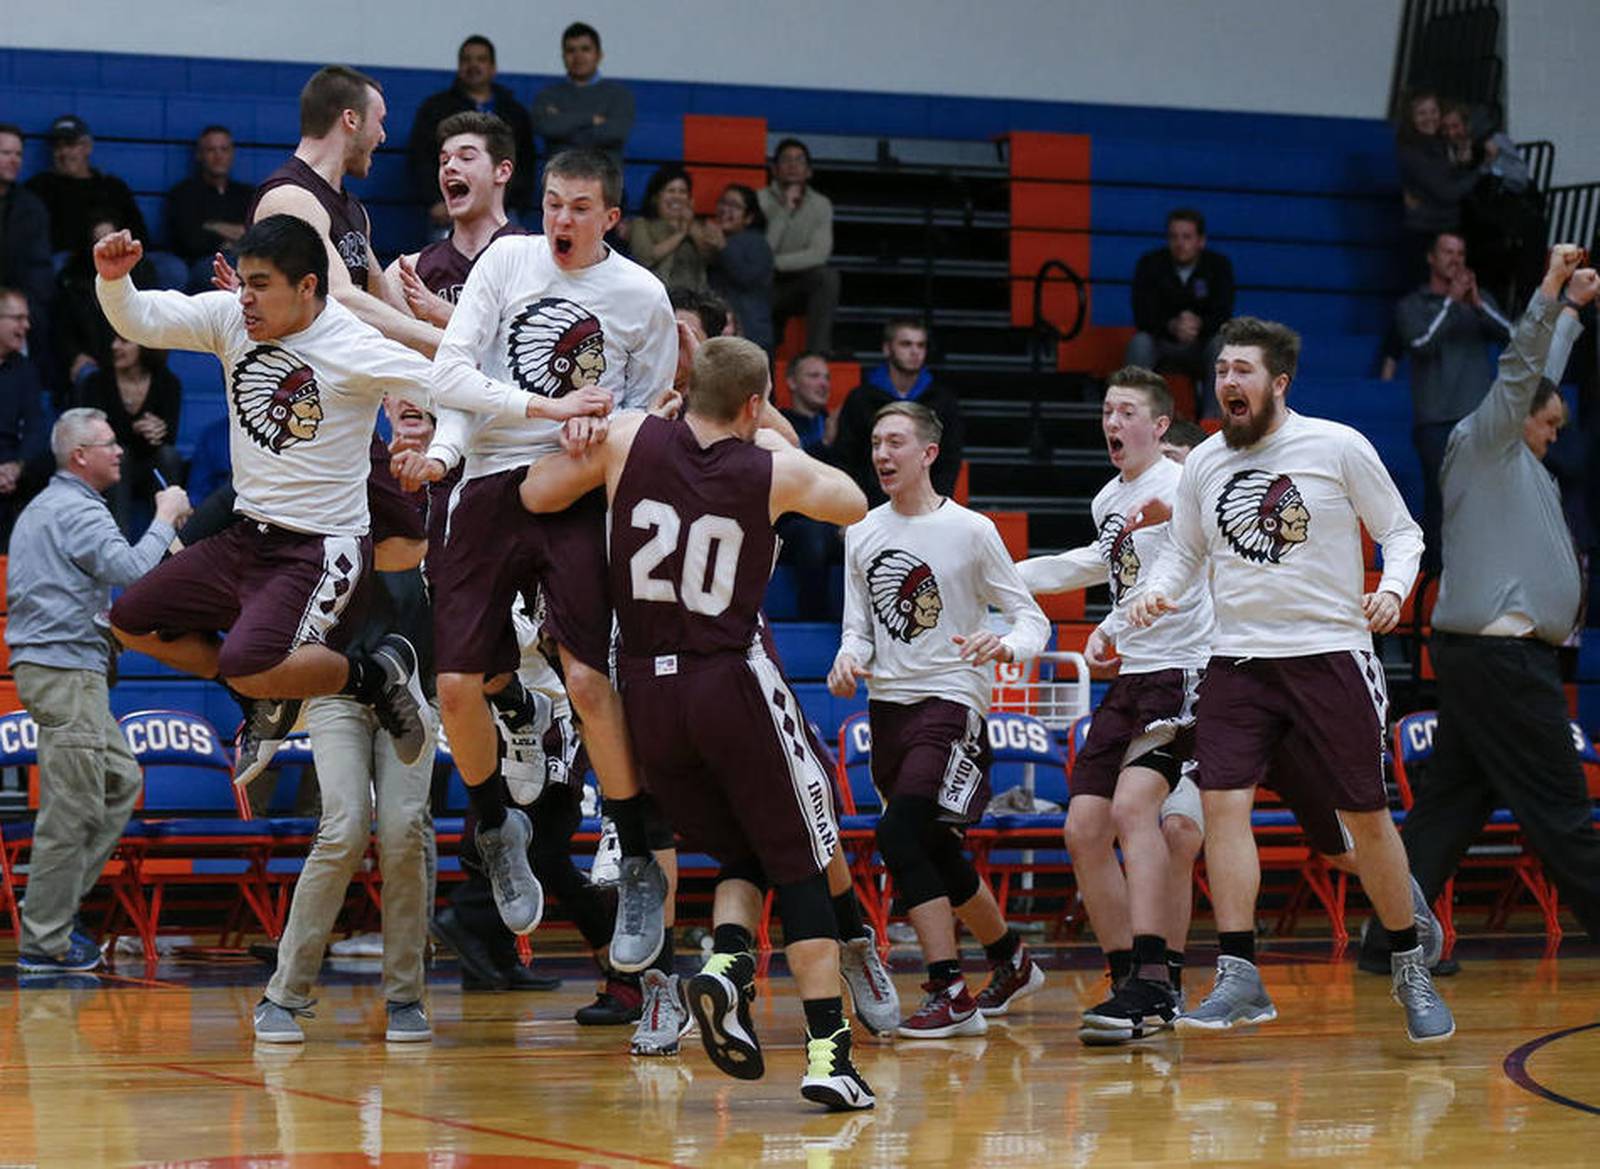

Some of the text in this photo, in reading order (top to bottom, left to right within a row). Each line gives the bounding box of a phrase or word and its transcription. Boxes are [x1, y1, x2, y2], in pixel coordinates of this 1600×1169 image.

[630, 498, 745, 617] 20
[0, 718, 39, 753] CO
[126, 719, 213, 754] COGS
[987, 719, 1049, 753] OGS
[1408, 718, 1439, 751] CO
[946, 759, 973, 802] DIANS
[808, 781, 836, 857] INDIANS
